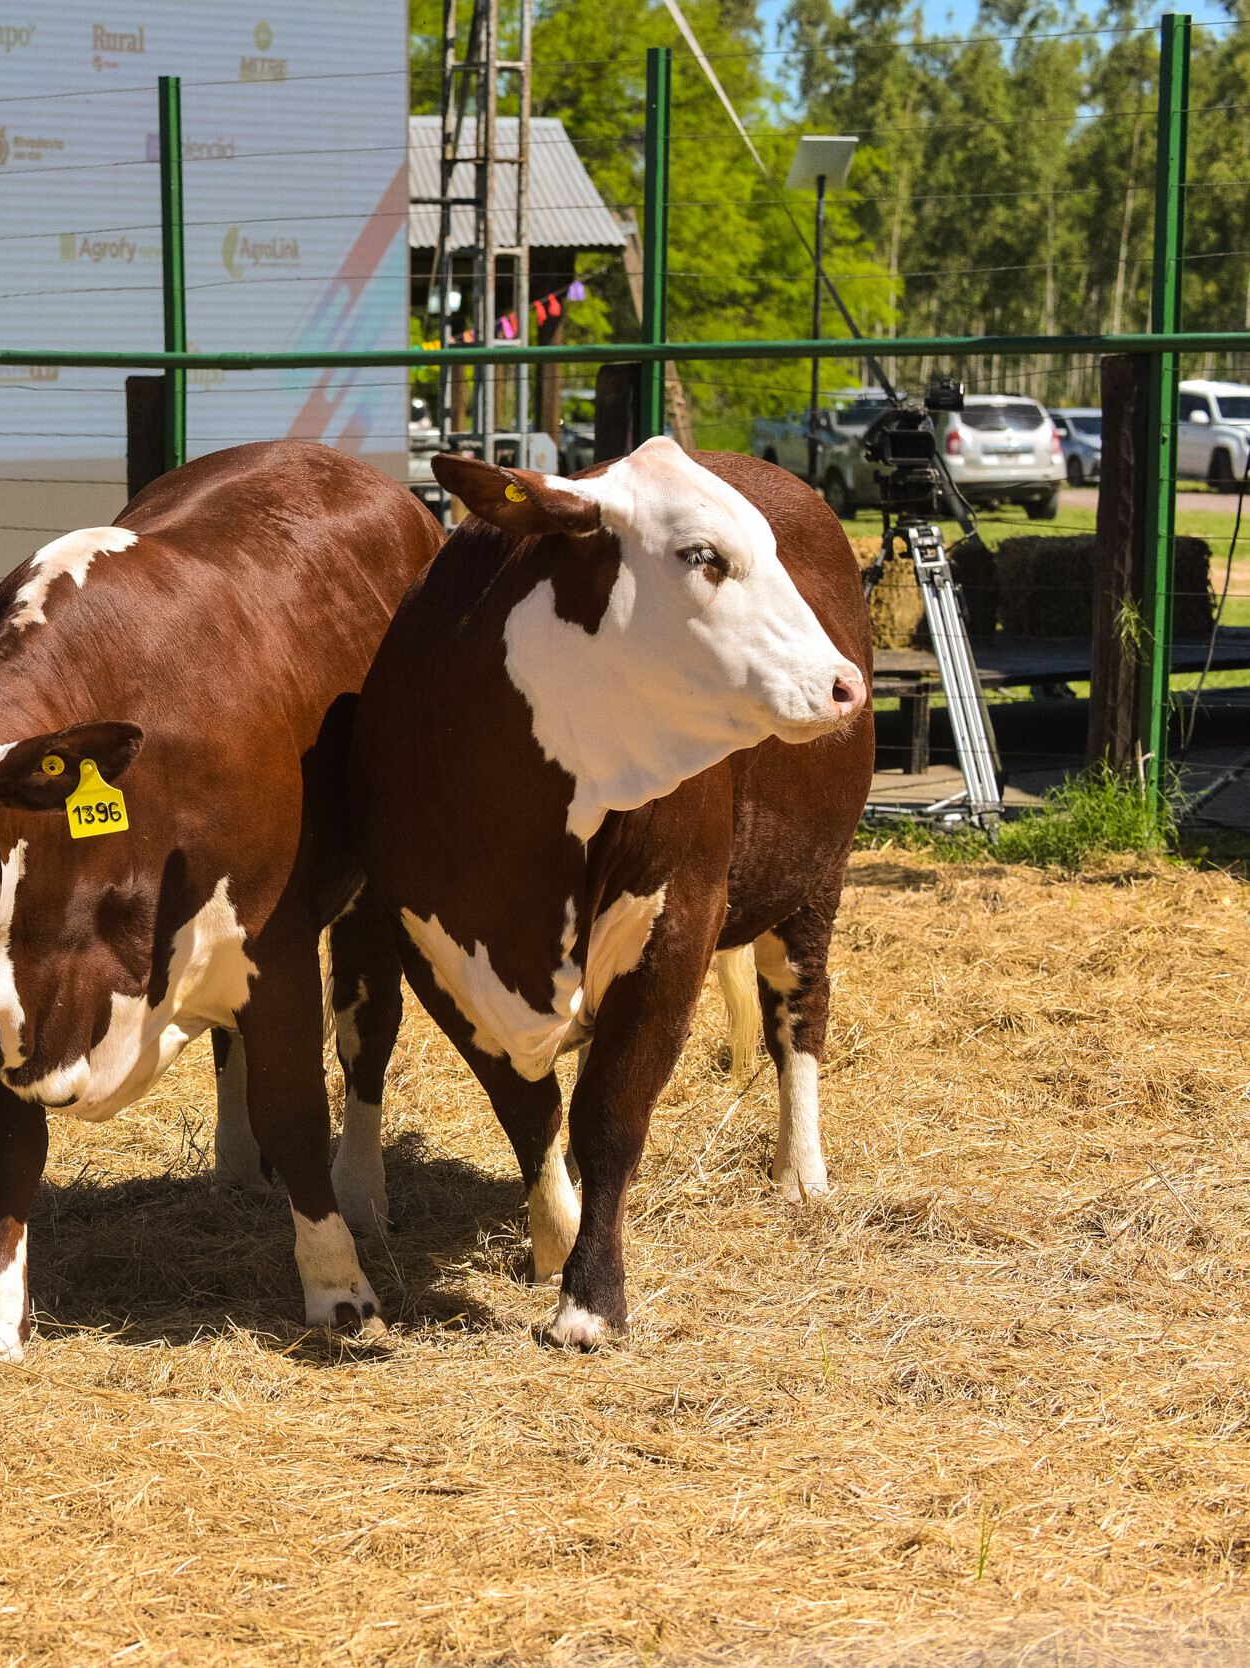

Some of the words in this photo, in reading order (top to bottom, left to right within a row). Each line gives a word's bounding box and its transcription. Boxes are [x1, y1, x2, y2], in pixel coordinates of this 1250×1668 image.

[92, 24, 145, 53] Rural
[79, 237, 136, 263] Agrofy
[71, 801, 122, 825] 1396
